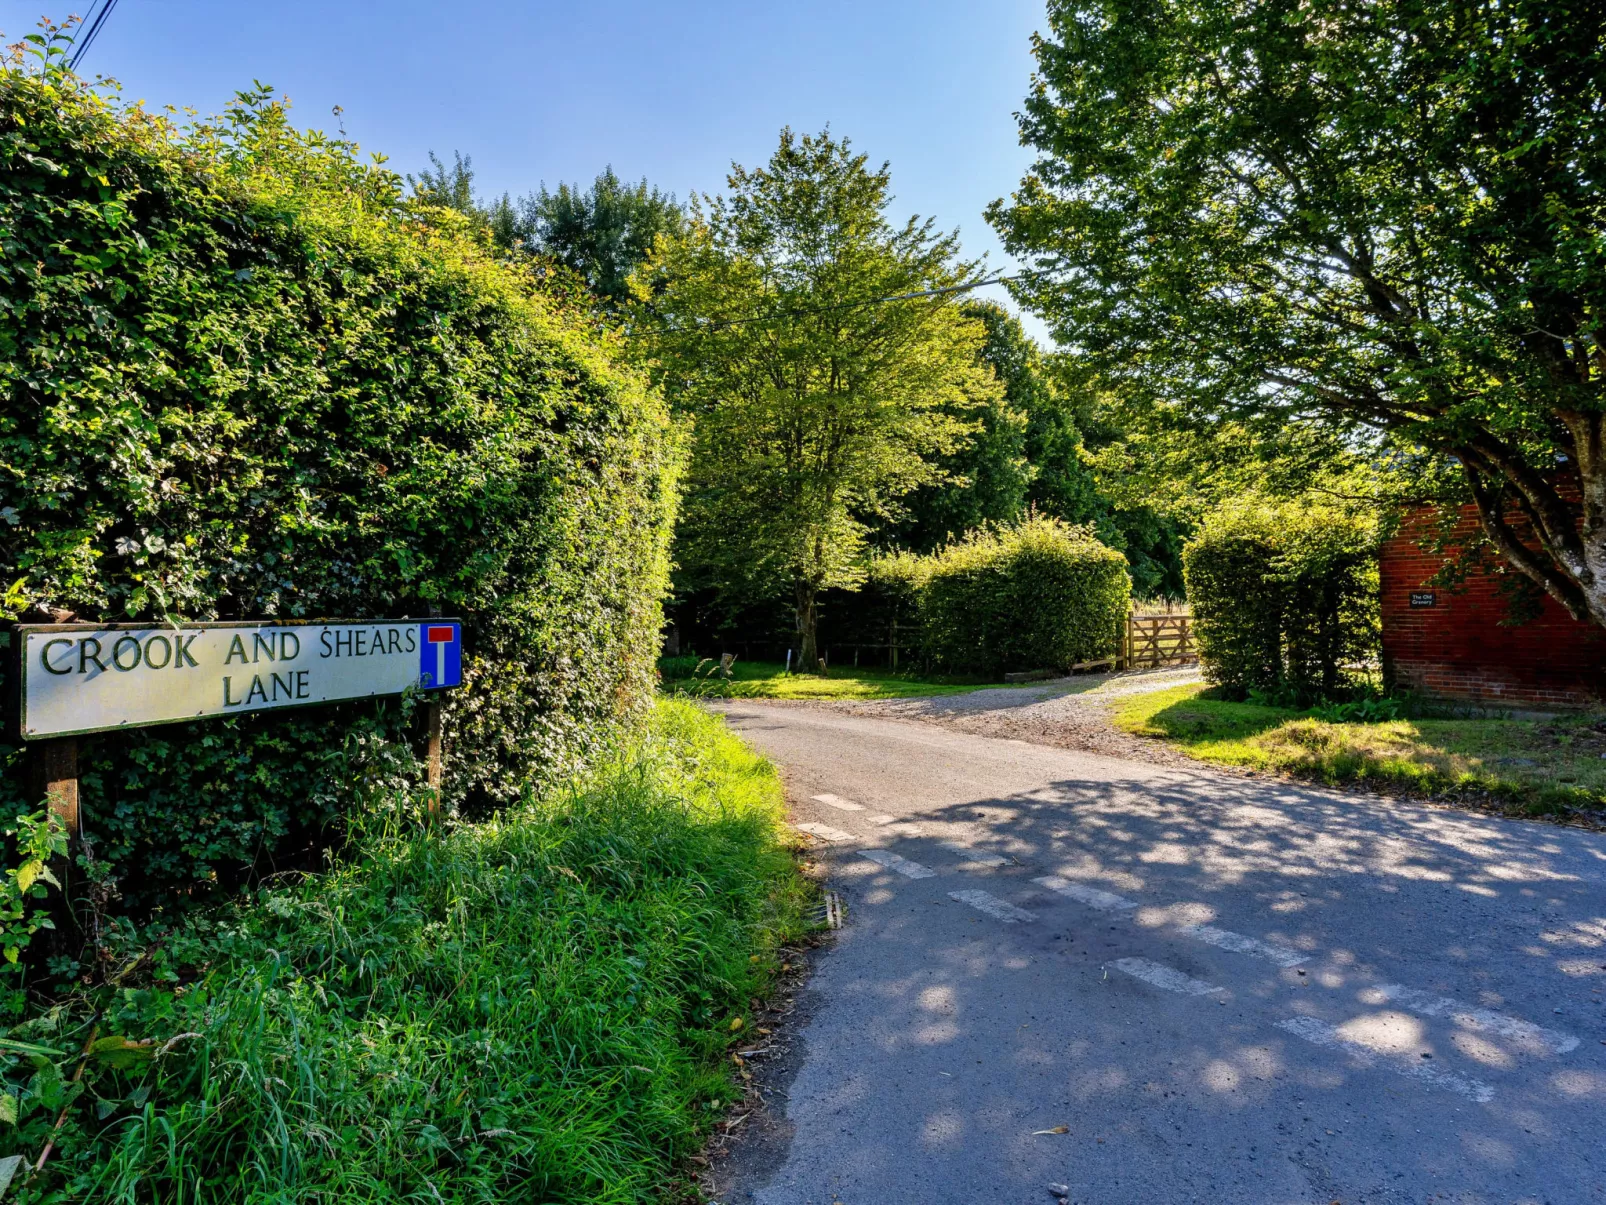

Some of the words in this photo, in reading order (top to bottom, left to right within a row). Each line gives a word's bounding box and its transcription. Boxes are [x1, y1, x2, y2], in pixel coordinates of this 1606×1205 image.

[41, 635, 200, 675] CROOK
[224, 632, 300, 664] AND
[320, 628, 416, 658] SHEARS
[223, 670, 310, 707] LANE
